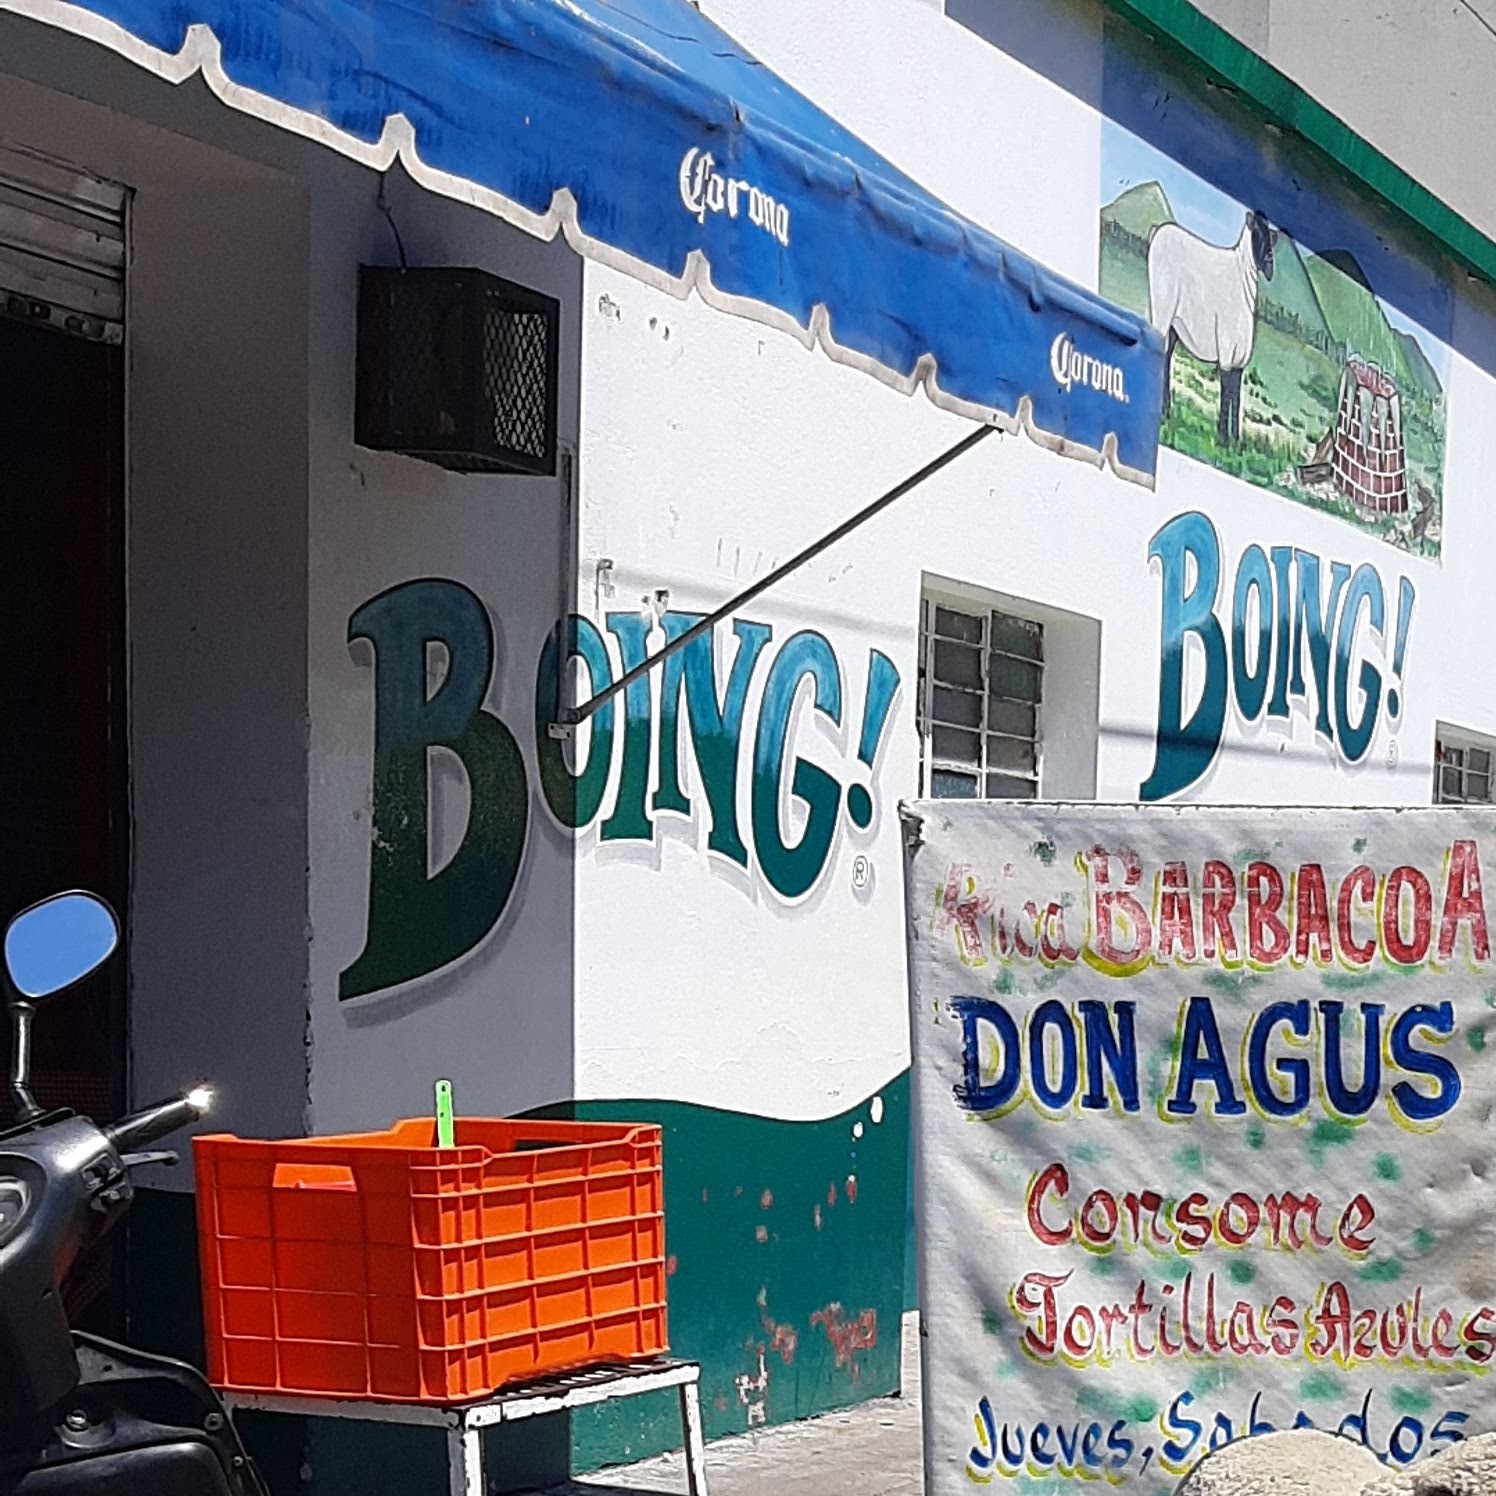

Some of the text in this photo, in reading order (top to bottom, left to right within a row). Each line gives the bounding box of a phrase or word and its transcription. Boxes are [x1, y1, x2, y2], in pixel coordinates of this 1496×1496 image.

[680, 146, 790, 248] Corona
[1050, 331, 1125, 402] Corona
[1138, 510, 1416, 802] BOING!
[338, 577, 901, 1002] BOING!
[1084, 840, 1492, 965] BARBACOA
[946, 995, 1462, 1121] DON AGUS
[1026, 1162, 1378, 1253] Consome
[1014, 1267, 1300, 1359] Tortillas
[967, 1395, 1154, 1476] Jueves,
